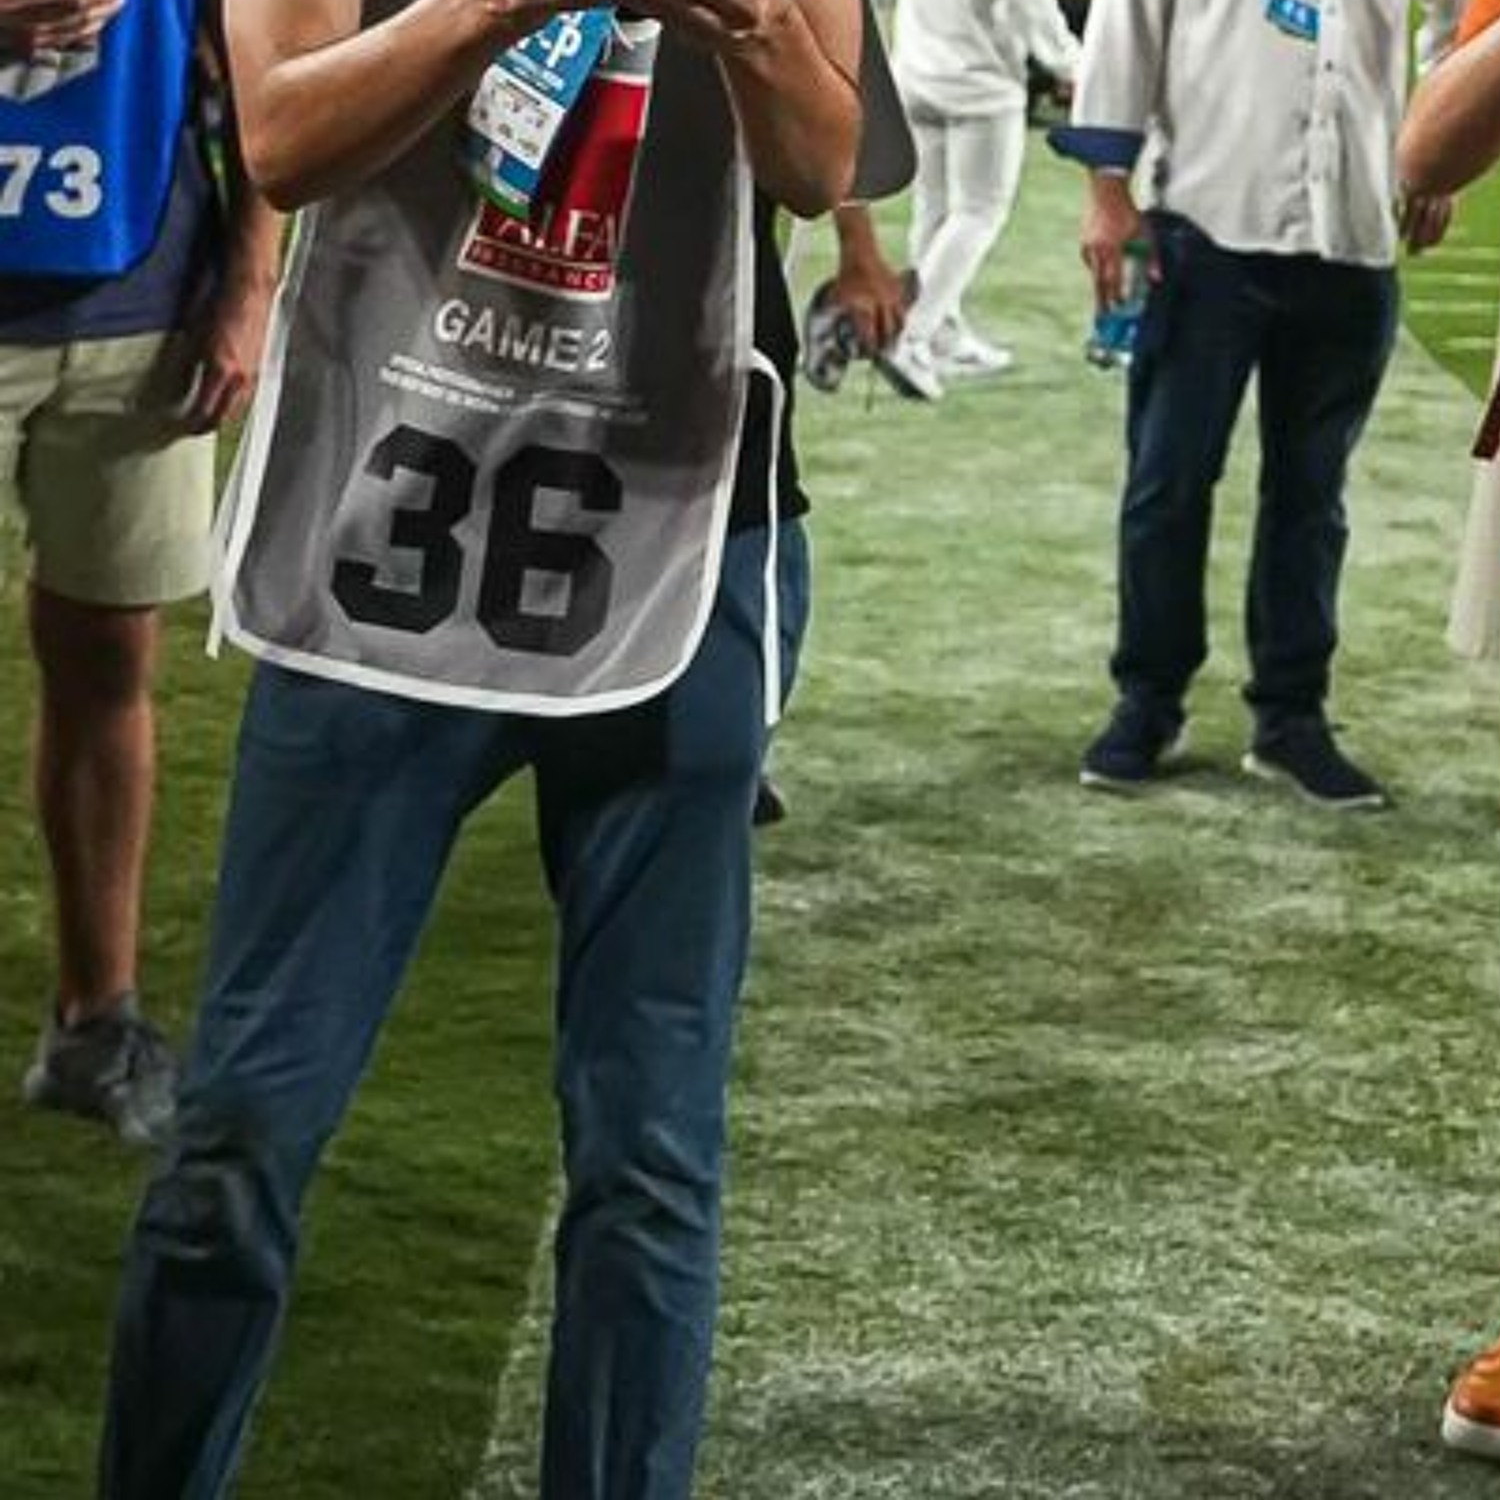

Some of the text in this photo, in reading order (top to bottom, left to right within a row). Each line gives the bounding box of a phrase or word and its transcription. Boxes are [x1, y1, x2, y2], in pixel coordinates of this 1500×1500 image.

[0, 145, 103, 219] 73
[435, 299, 613, 372] GAME 2
[331, 423, 624, 657] 36
